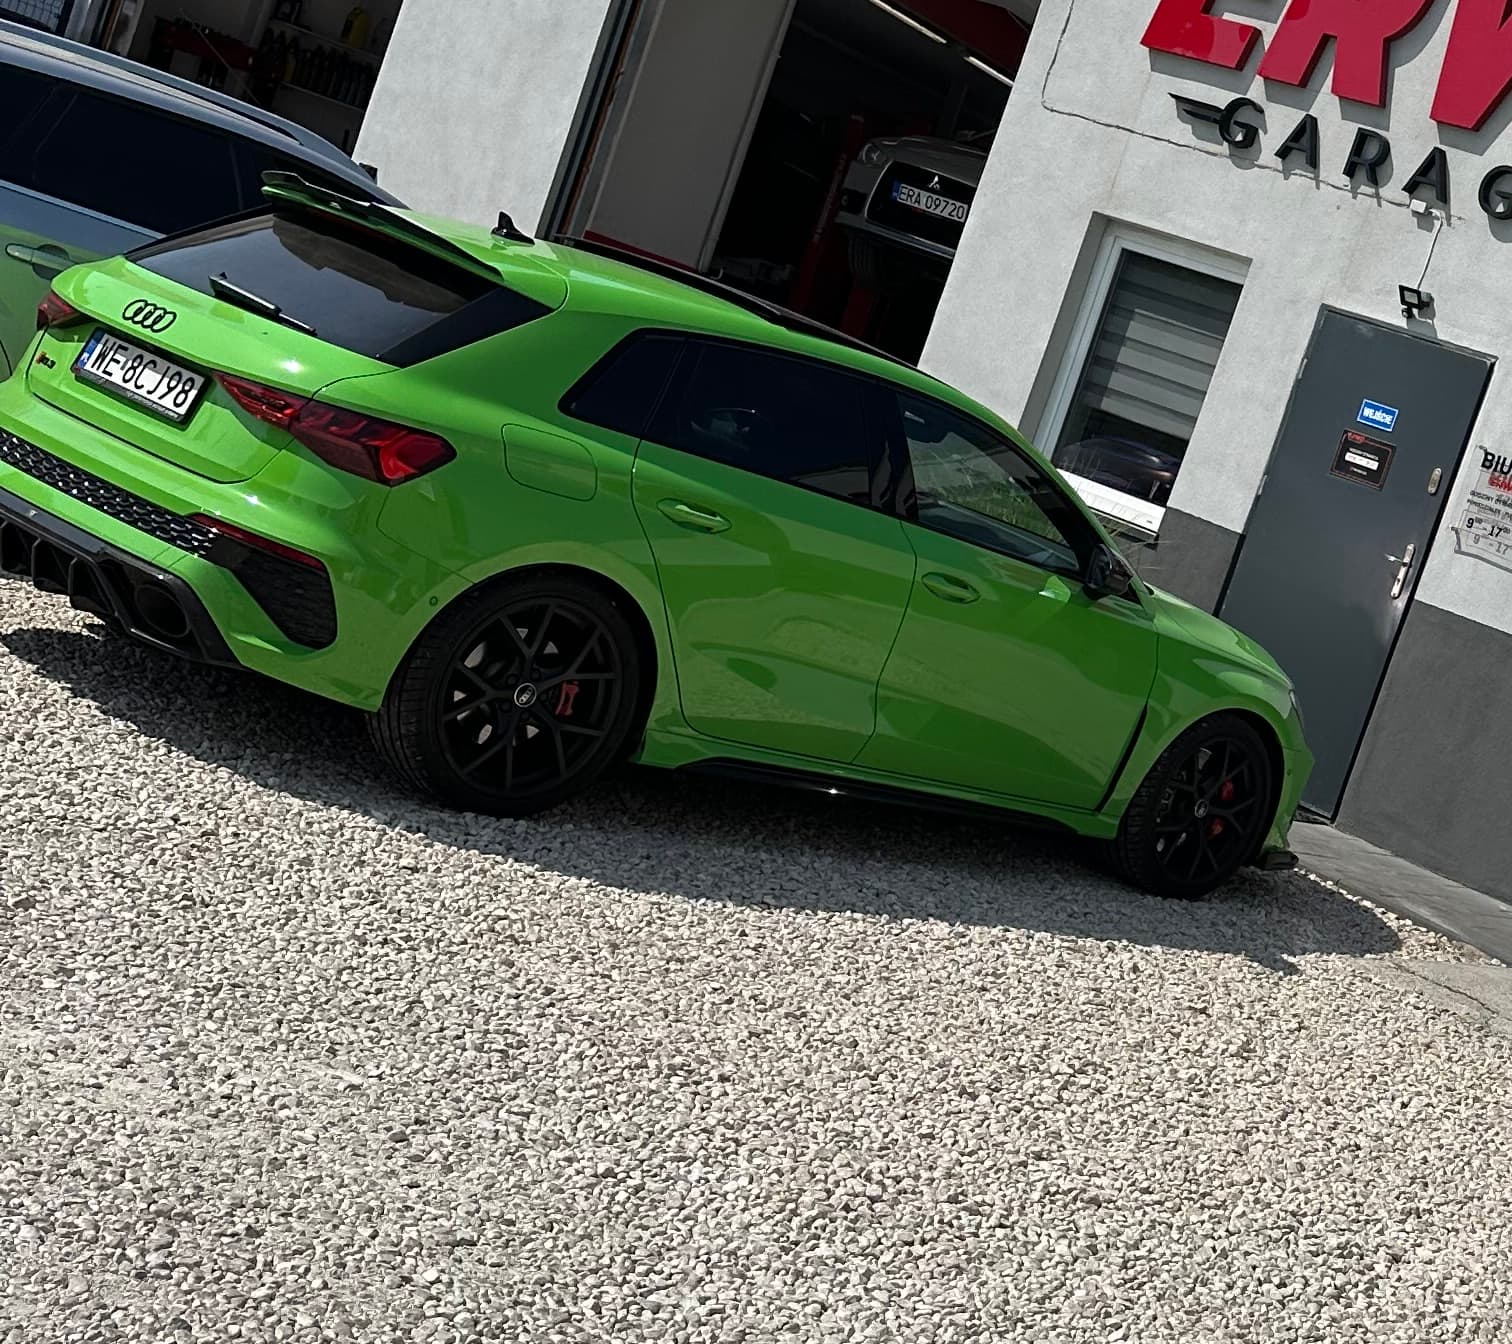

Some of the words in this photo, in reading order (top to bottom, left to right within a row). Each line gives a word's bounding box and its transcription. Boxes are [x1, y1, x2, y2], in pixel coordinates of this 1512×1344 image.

[899, 185, 921, 207] ERA
[924, 194, 966, 220] 09720
[90, 338, 129, 377] WE
[121, 353, 196, 408] 8CJ98
